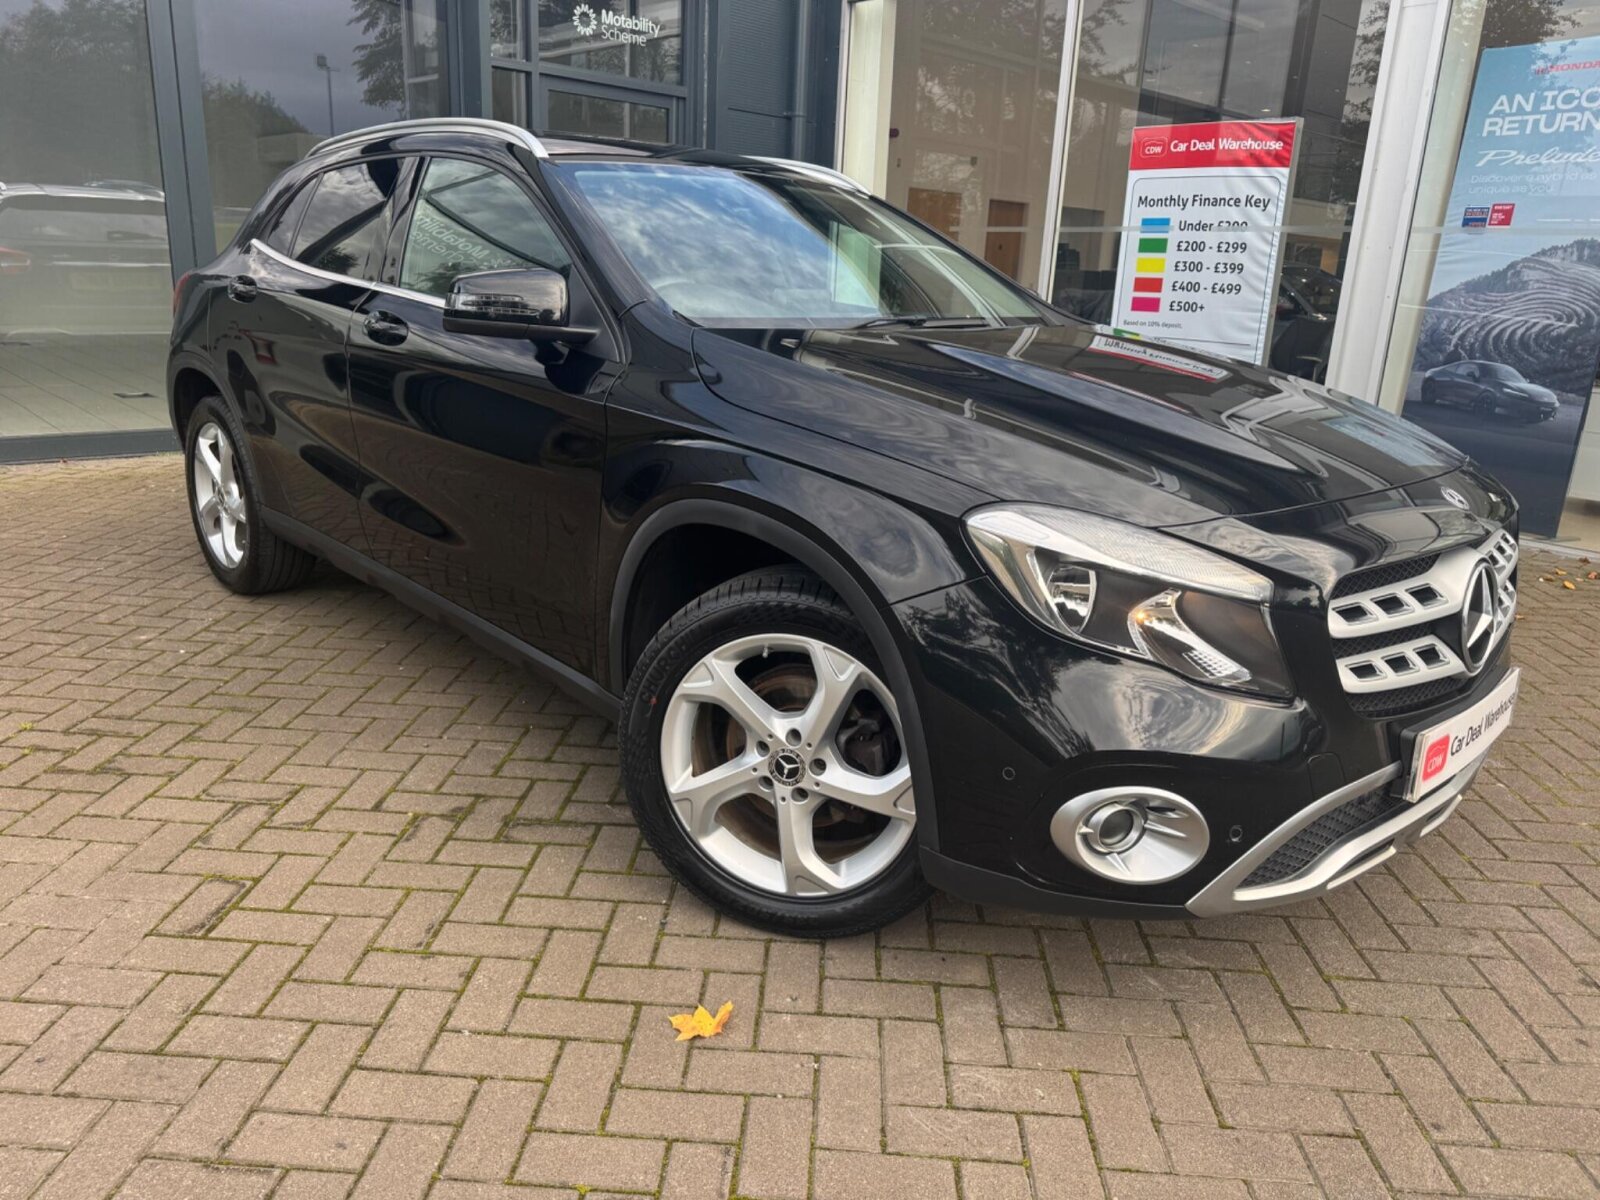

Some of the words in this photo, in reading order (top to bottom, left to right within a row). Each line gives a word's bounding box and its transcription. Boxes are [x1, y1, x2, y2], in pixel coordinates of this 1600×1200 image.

[601, 9, 660, 37] Motability
[601, 24, 647, 46] Scheme
[1488, 91, 1535, 115] AN
[1145, 145, 1162, 154] CDW
[1170, 140, 1189, 152] Car
[1190, 138, 1215, 151] Deal
[1218, 137, 1284, 150] Warehouse
[1137, 195, 1189, 210] Monthly
[1191, 194, 1241, 207] Finance
[1244, 195, 1271, 212] Key
[1178, 220, 1214, 231] Under
[1176, 241, 1206, 252] £200
[1216, 241, 1247, 253] £299
[1174, 260, 1203, 272] £300
[1214, 262, 1244, 274] £399
[1171, 280, 1201, 292] £400
[1211, 282, 1242, 295] £499
[1169, 300, 1205, 312] £500+
[1451, 735, 1465, 756] Car
[1465, 716, 1484, 747] Deal
